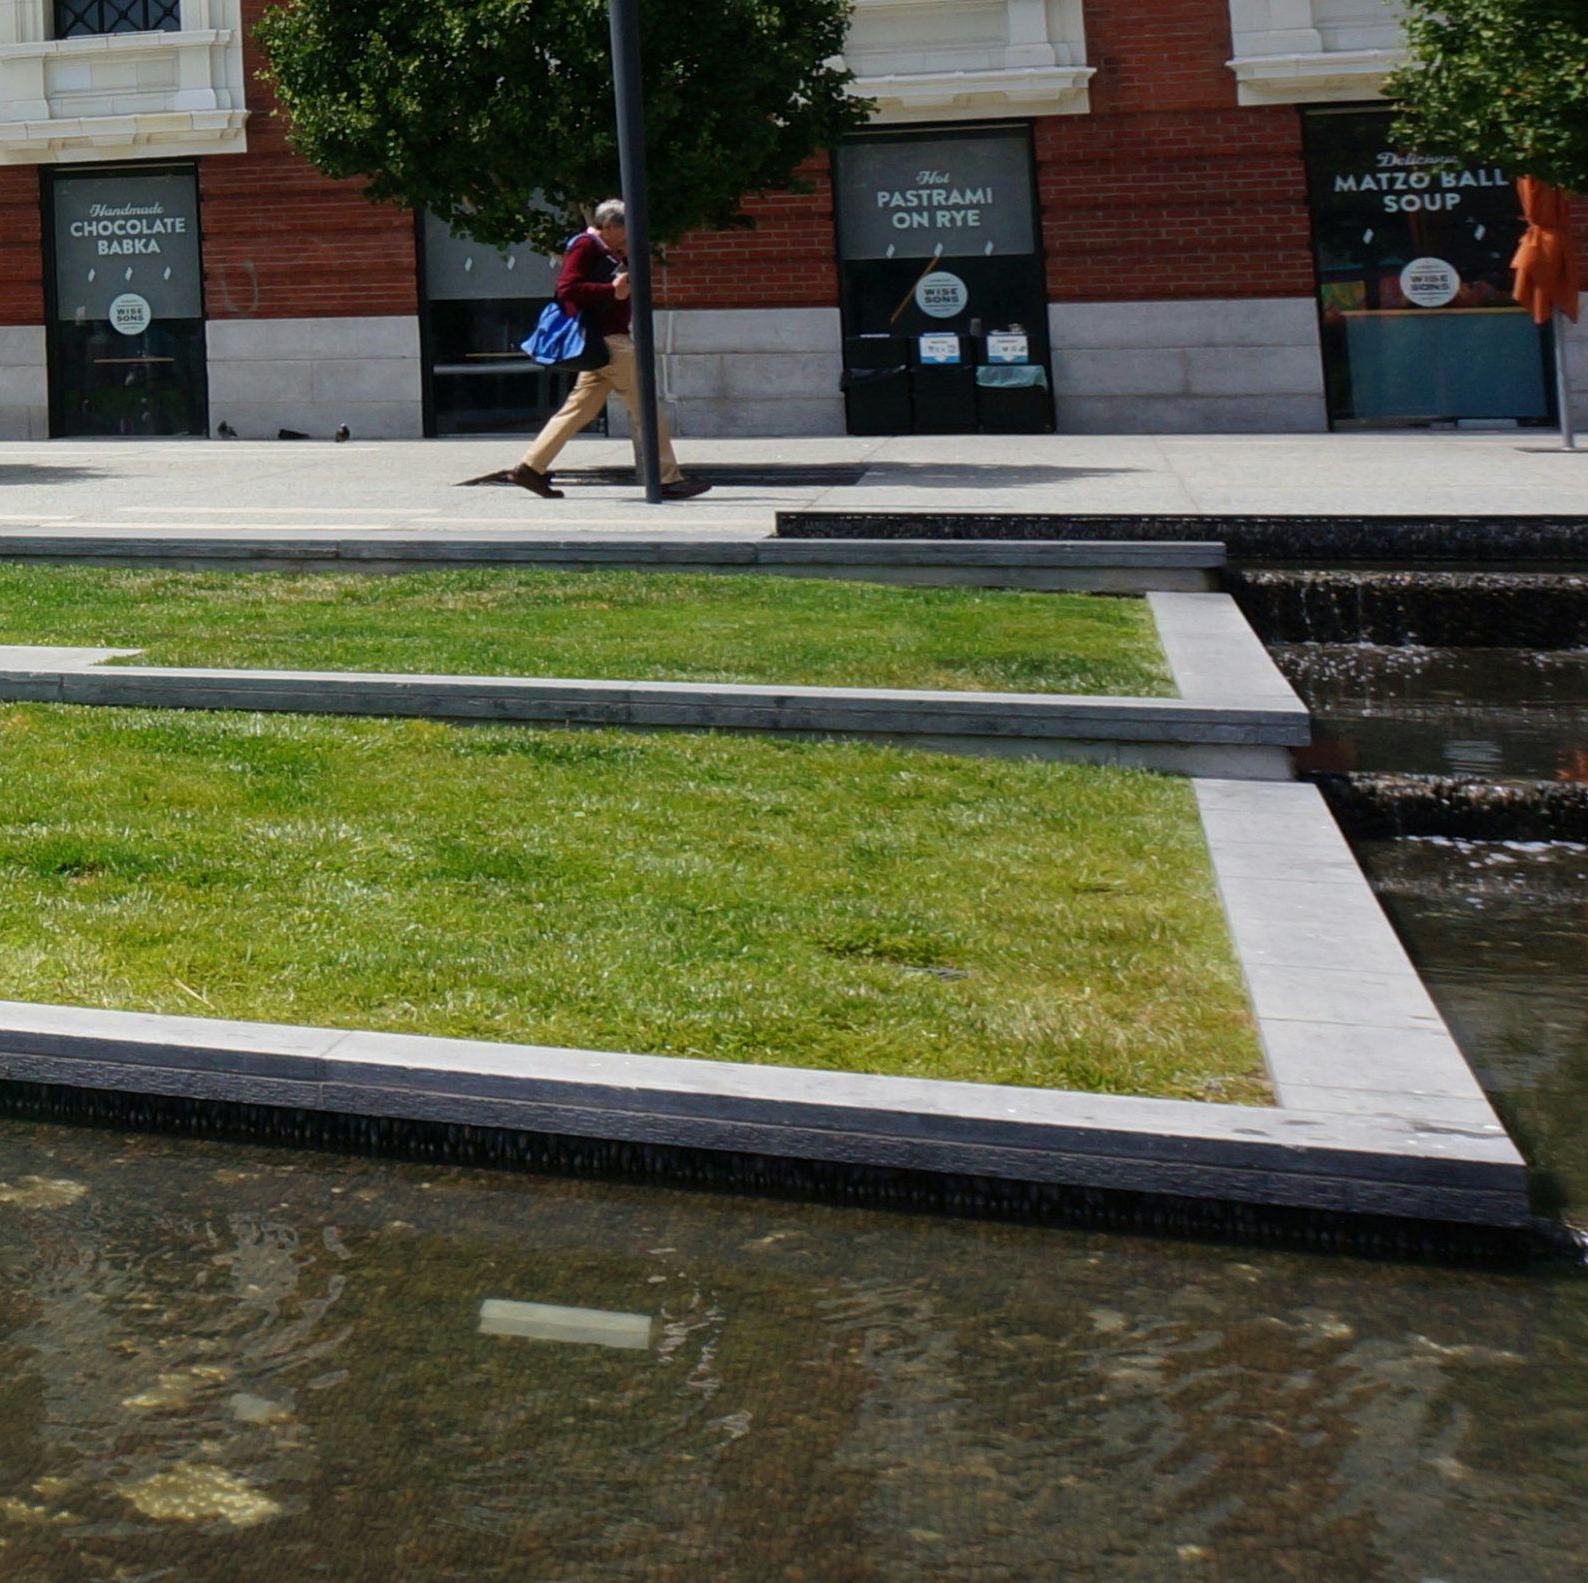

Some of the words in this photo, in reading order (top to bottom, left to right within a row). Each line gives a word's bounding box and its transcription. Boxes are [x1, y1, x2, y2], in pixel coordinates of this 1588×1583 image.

[915, 169, 950, 185] Hot
[1334, 171, 1431, 192] MATZO
[1440, 168, 1509, 188] BALL
[876, 186, 994, 208] PASTRAMI
[1383, 192, 1461, 214] SOUP
[89, 201, 164, 217] Handmade
[69, 217, 186, 237] CHOCOLATE
[891, 211, 929, 230] ON
[935, 209, 981, 228] RYE
[97, 237, 161, 256] BABKA
[1409, 274, 1449, 283] WISE
[924, 287, 958, 296] WISE
[1410, 283, 1449, 291] SONS
[924, 295, 959, 303] SONS
[116, 307, 143, 315] WISE
[116, 314, 144, 322] SONS
